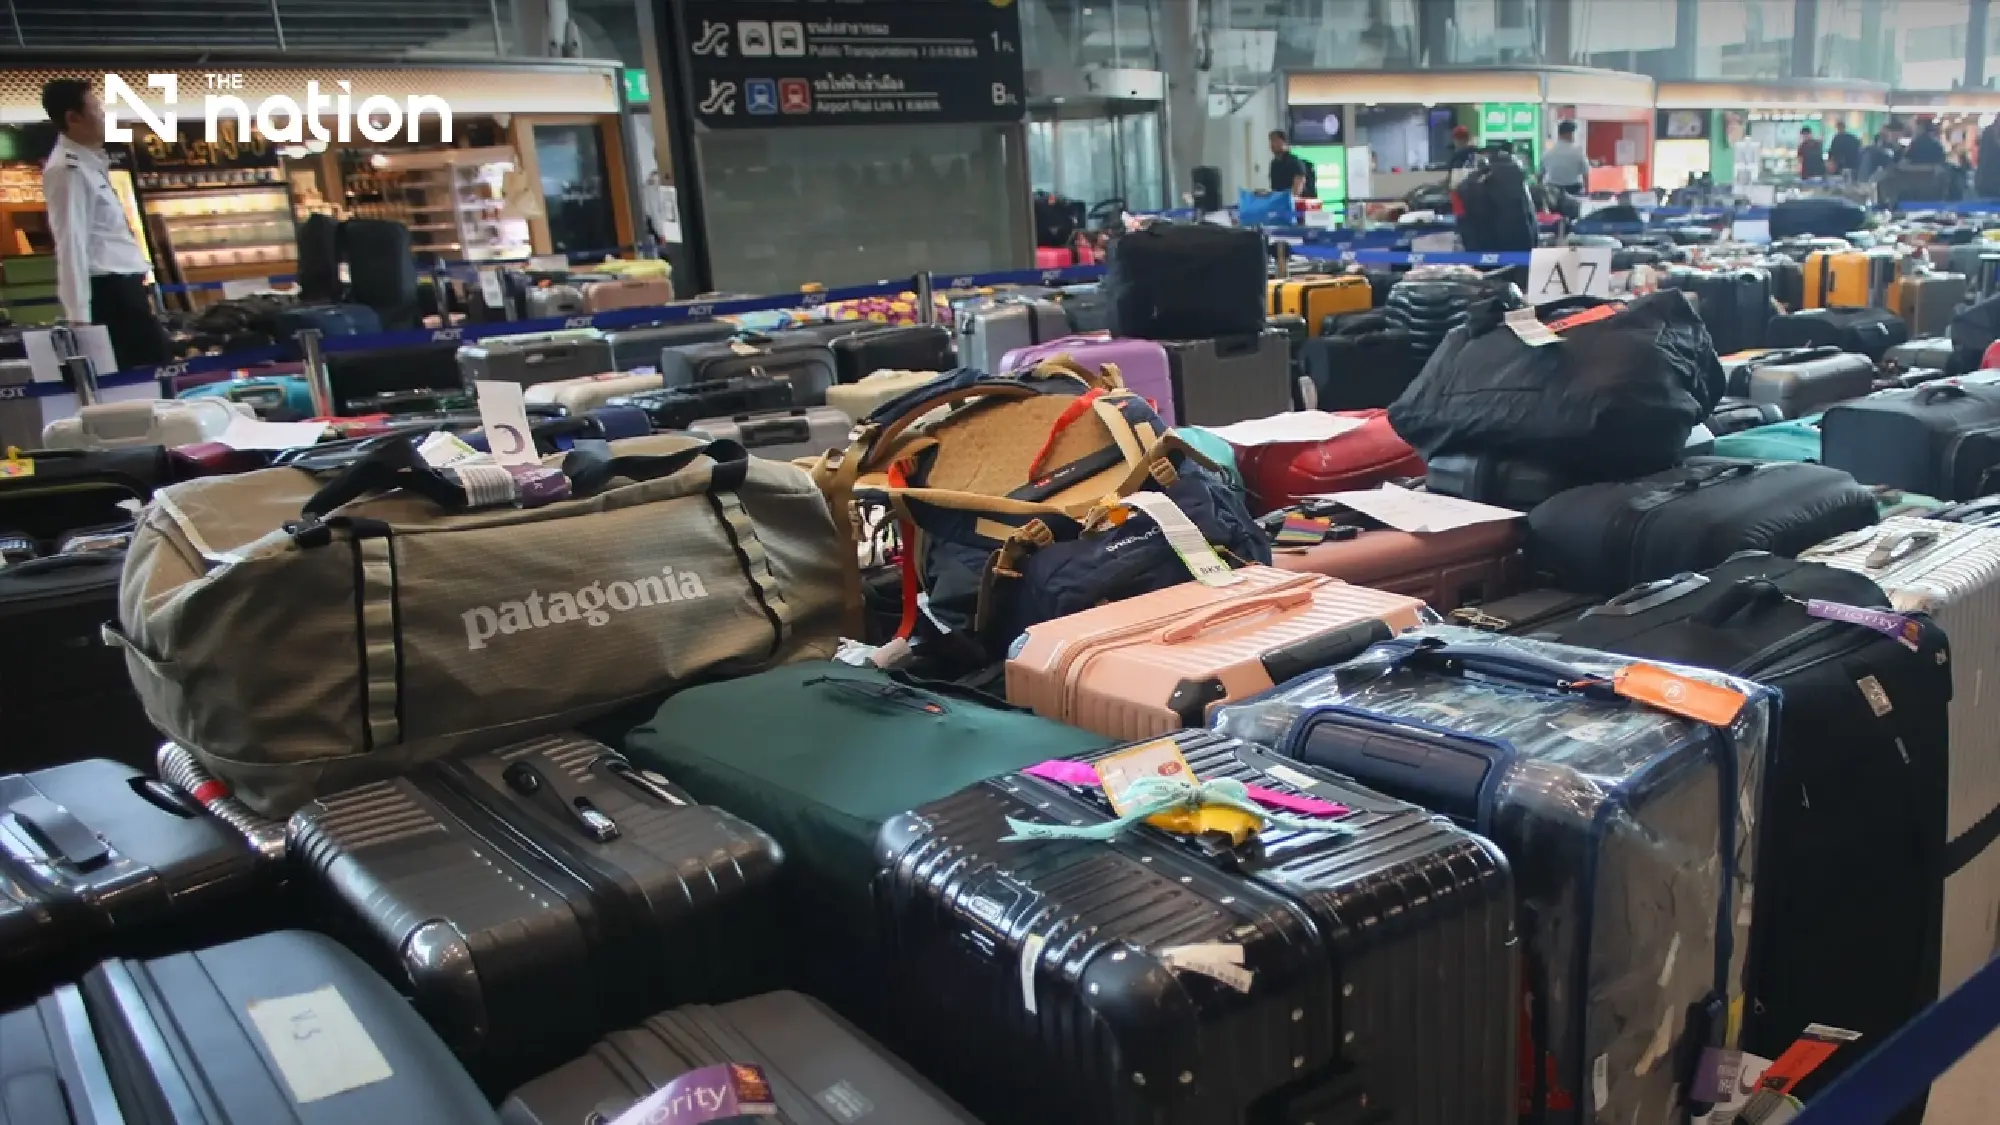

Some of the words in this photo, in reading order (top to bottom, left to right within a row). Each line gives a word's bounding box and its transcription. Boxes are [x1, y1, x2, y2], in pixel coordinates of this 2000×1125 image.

[817, 100, 850, 114] Airport
[852, 99, 872, 111] Rail
[564, 317, 594, 329] AOT
[431, 328, 463, 341] AOT
[154, 362, 189, 380] AOT
[0, 385, 26, 398] OT
[461, 565, 708, 650] patagonia
